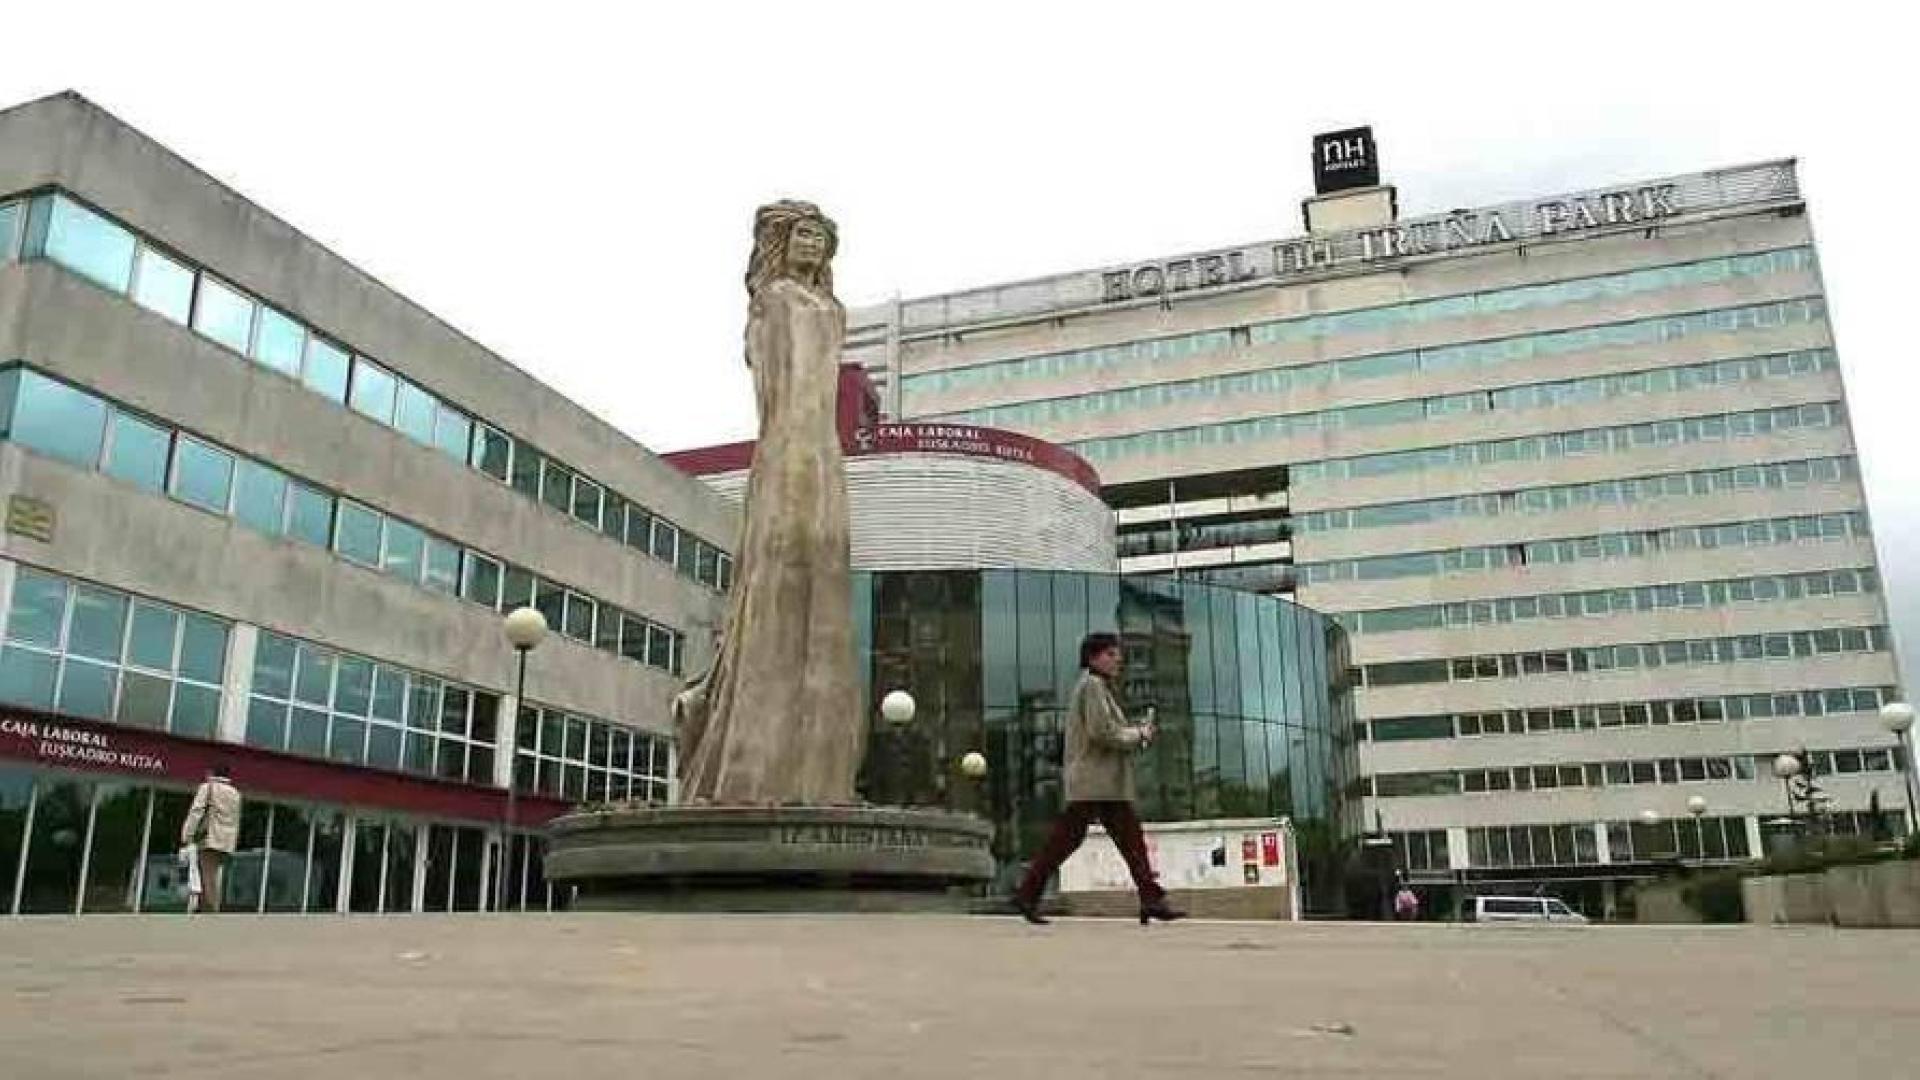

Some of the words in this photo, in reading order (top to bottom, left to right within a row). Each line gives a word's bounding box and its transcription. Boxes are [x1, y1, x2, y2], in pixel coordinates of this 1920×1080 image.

[1101, 250, 1256, 304] HOTEL
[1536, 184, 1681, 235] PARK
[878, 427, 912, 438] CAJA
[918, 427, 981, 439] LABORAL
[0, 719, 38, 737] CAJA
[42, 726, 109, 748] LABORAL
